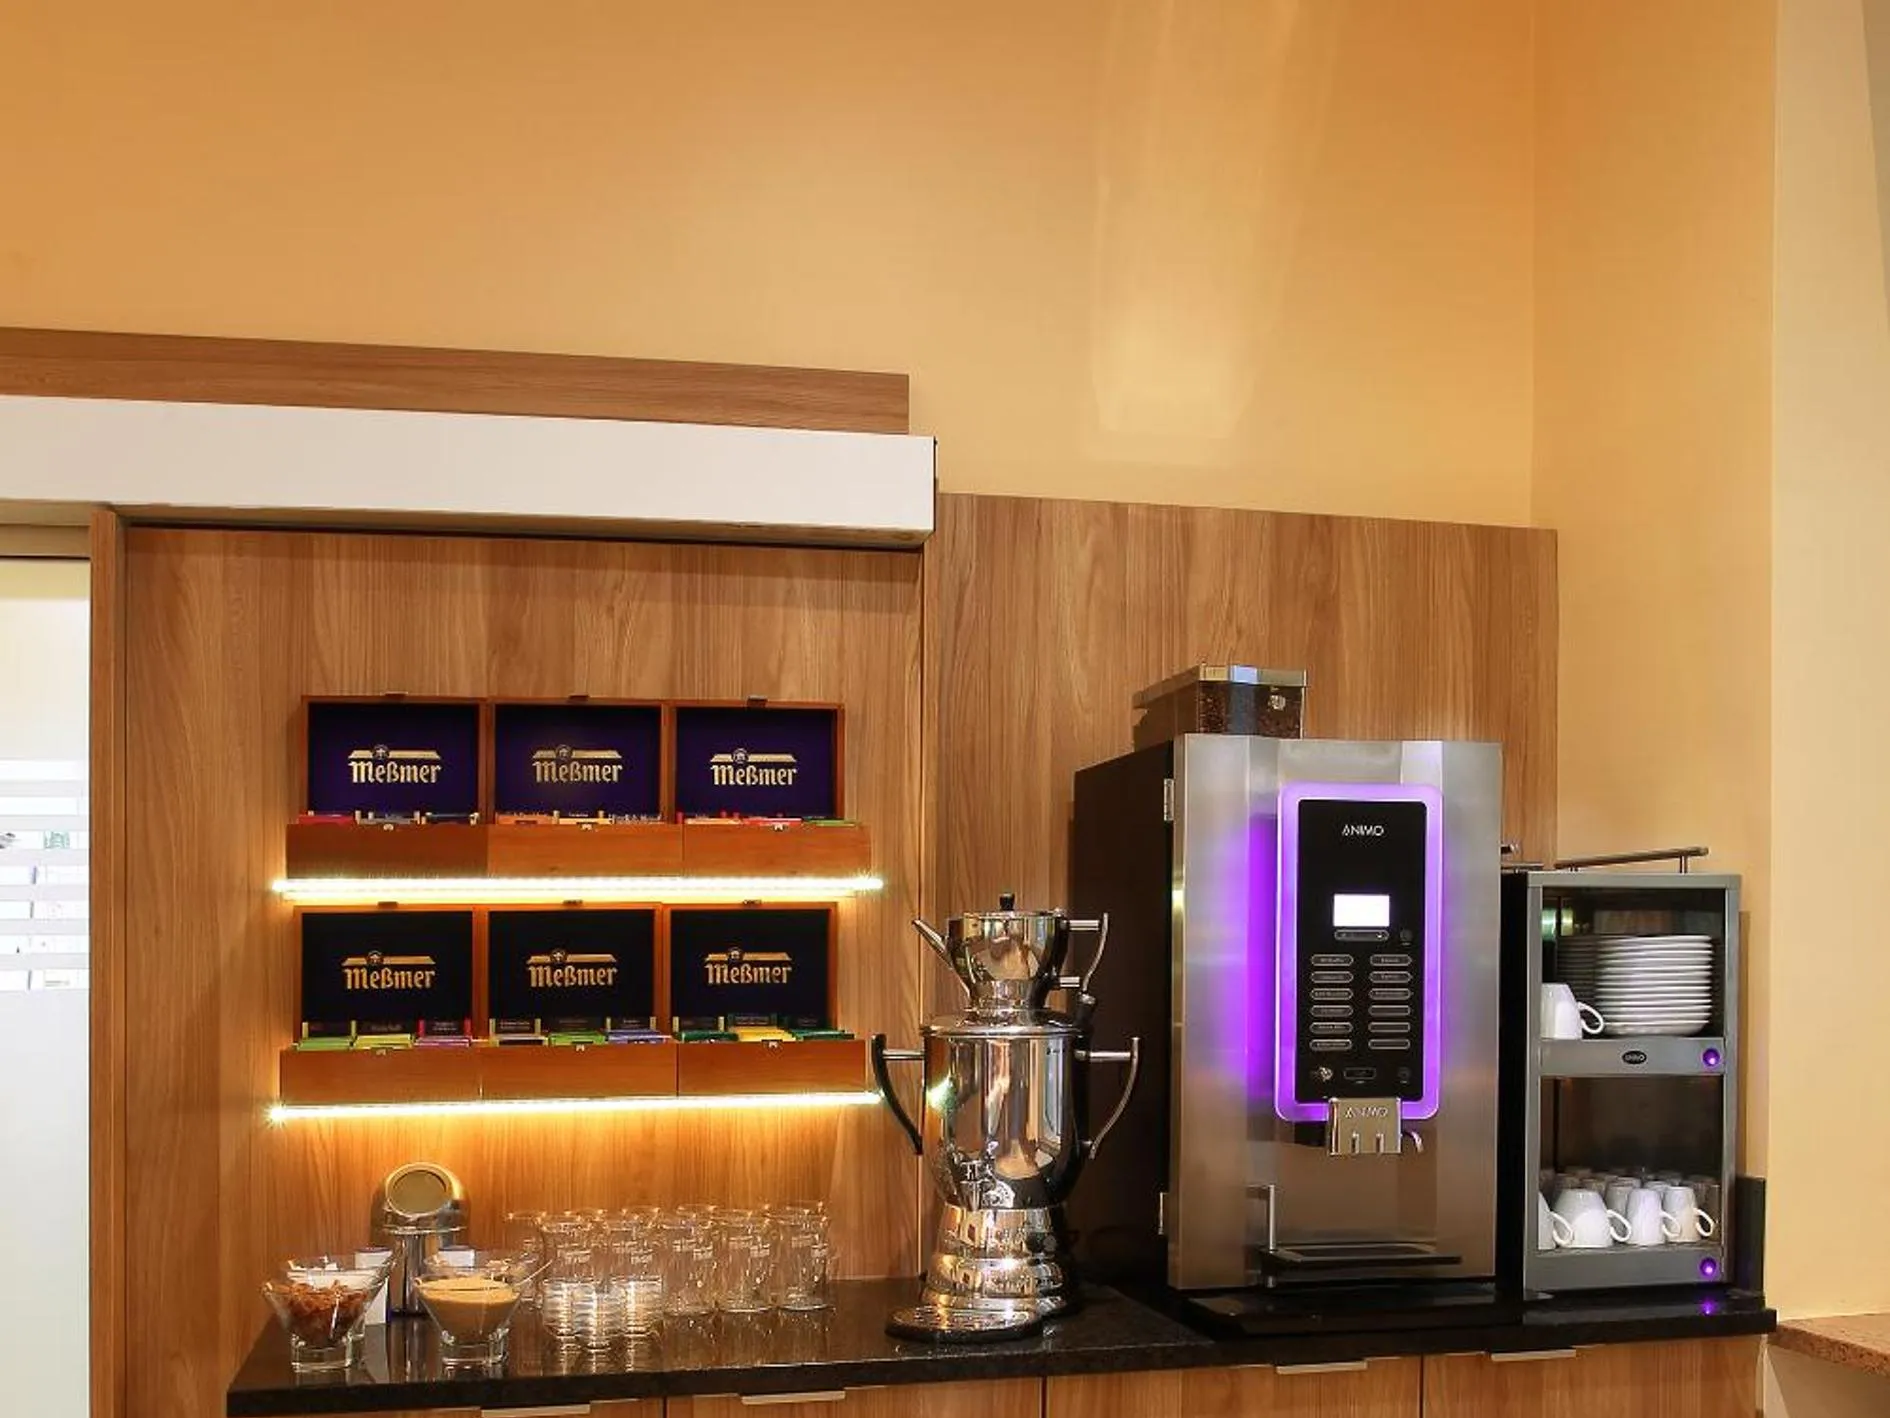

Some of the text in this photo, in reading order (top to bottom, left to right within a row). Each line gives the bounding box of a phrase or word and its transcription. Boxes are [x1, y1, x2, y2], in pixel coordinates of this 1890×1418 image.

[349, 761, 442, 783] Meßmer
[532, 761, 623, 783] Meßmer
[710, 765, 798, 786] Meßmer
[343, 967, 436, 989] Meßmer
[528, 965, 618, 987] Meßmer
[704, 963, 792, 984] Meßmer
